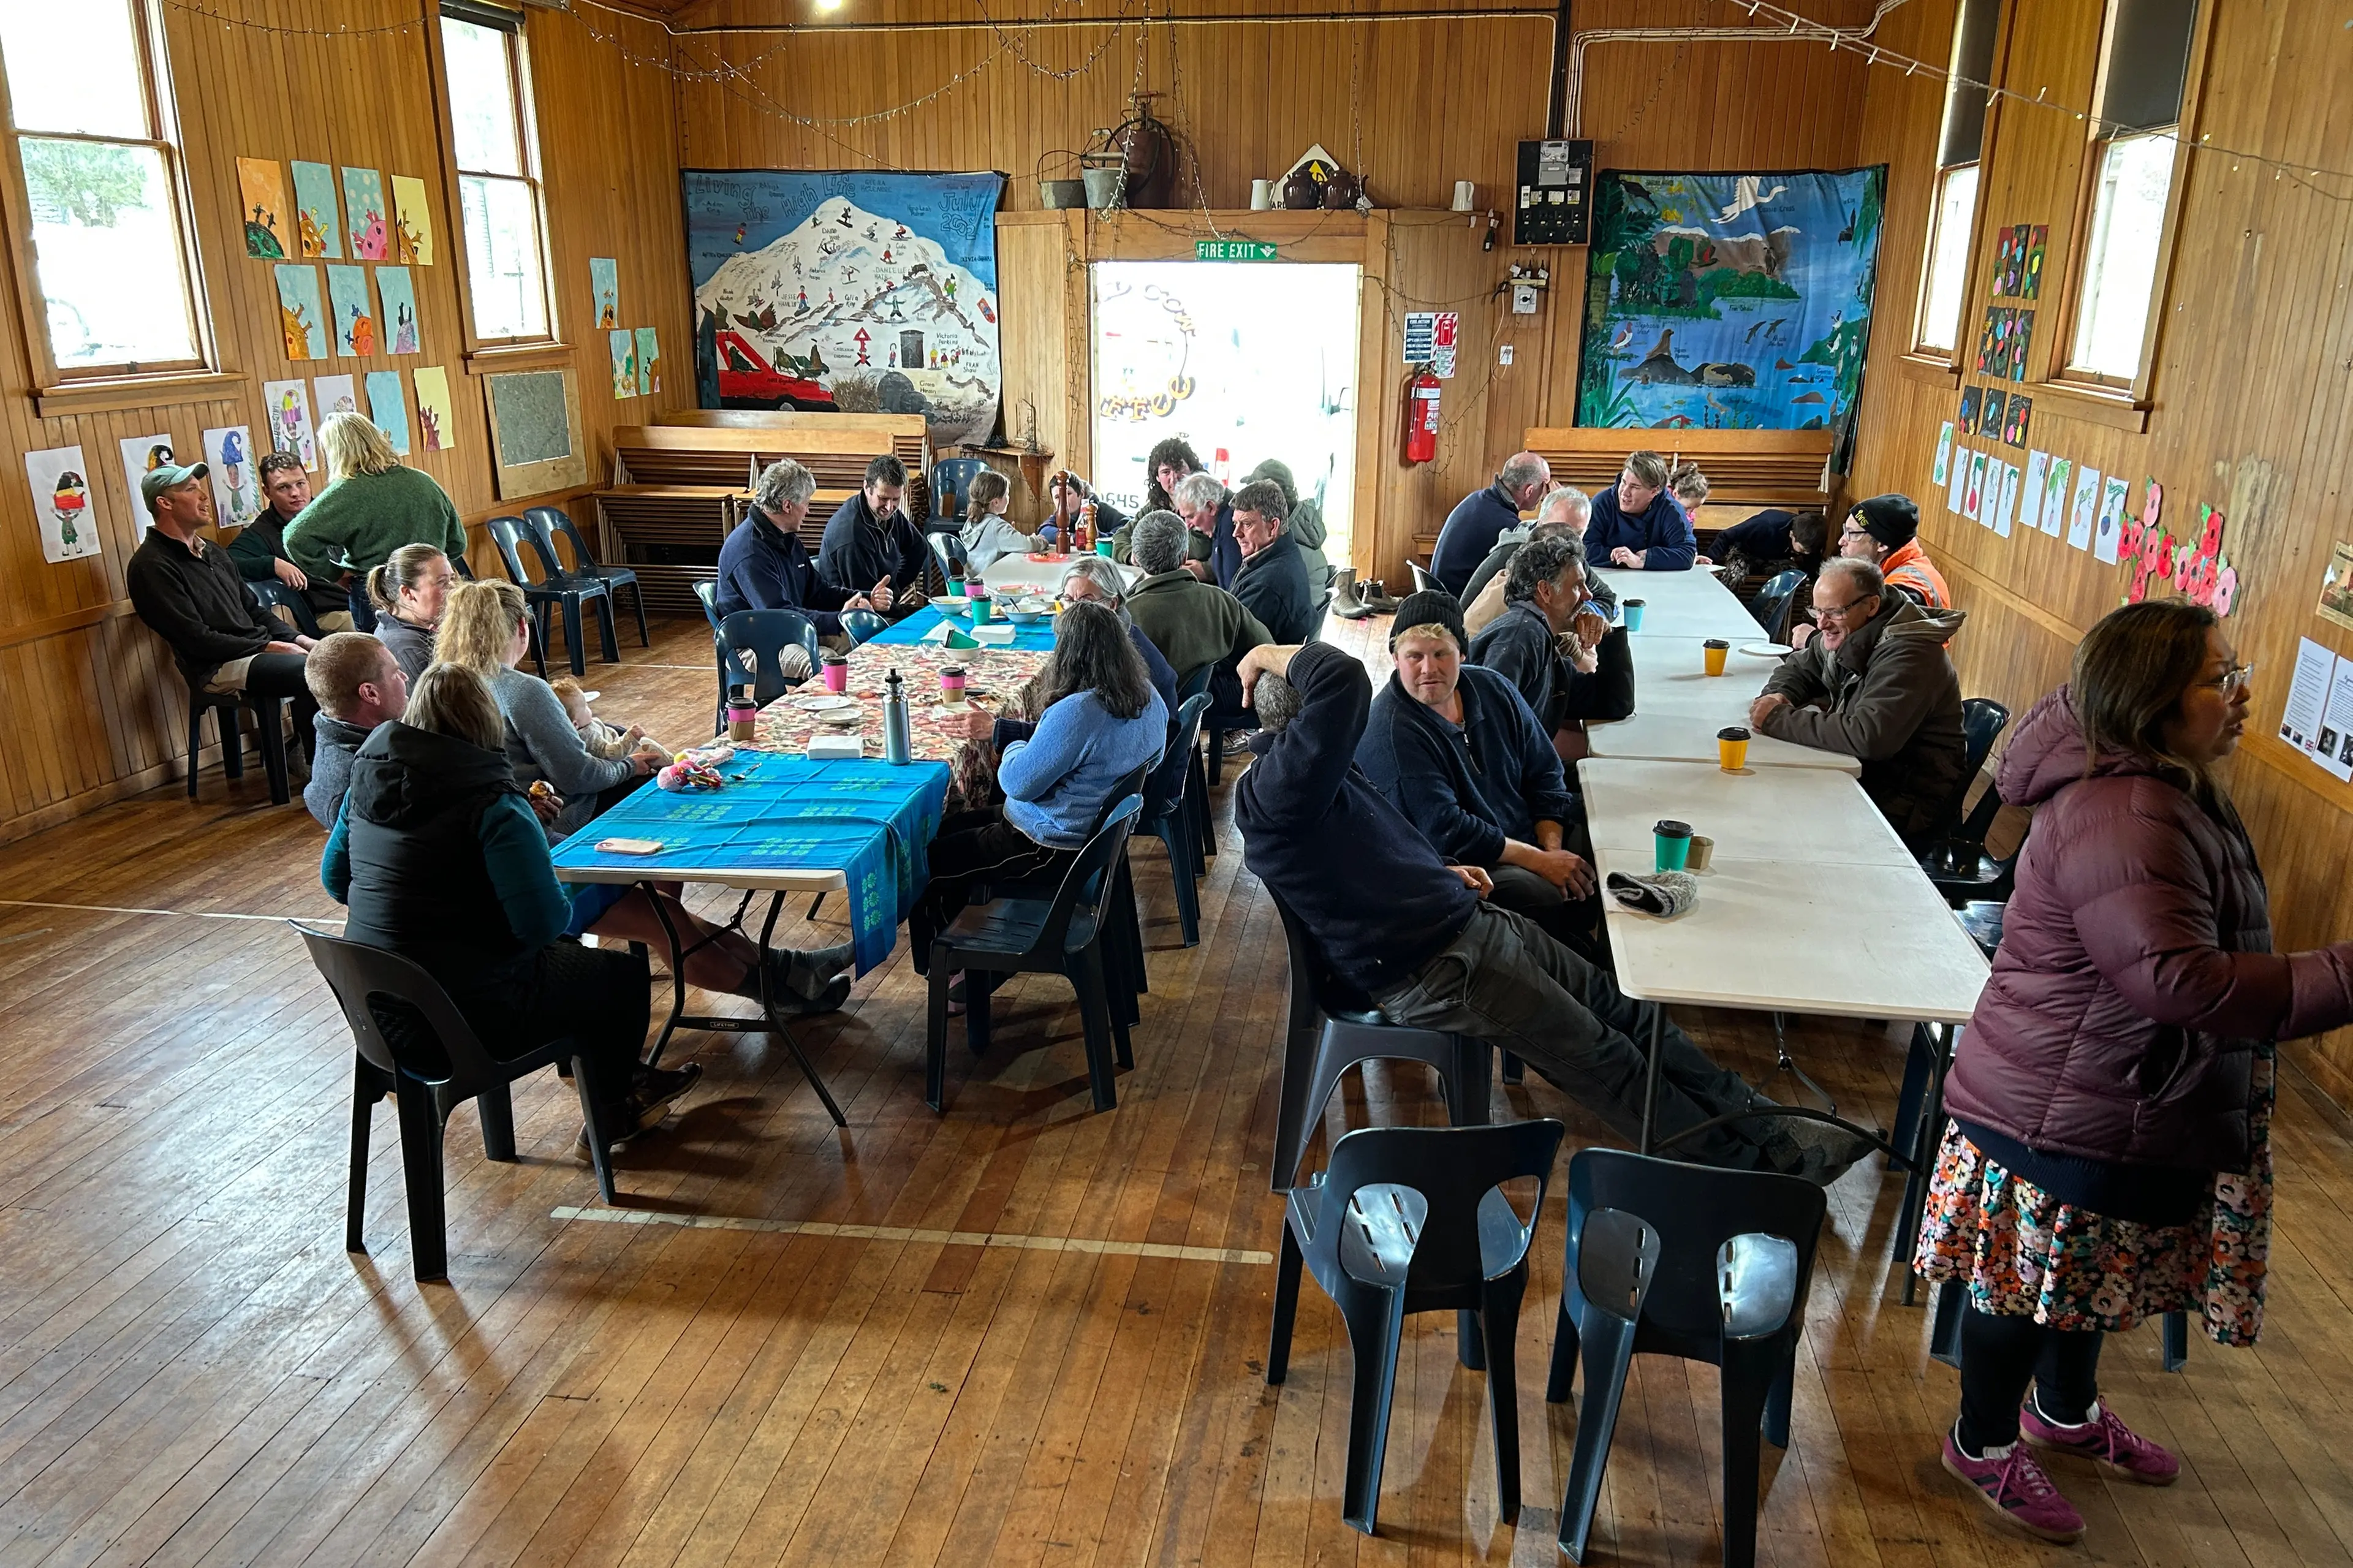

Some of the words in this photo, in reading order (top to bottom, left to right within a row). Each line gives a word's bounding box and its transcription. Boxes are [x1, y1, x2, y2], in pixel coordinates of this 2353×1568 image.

[695, 175, 757, 209] Living
[781, 183, 819, 218] High
[821, 174, 856, 199] Life
[938, 191, 982, 224] July
[940, 213, 977, 240] 2002
[1198, 243, 1224, 258] FIRE
[1229, 243, 1256, 259] EXIT
